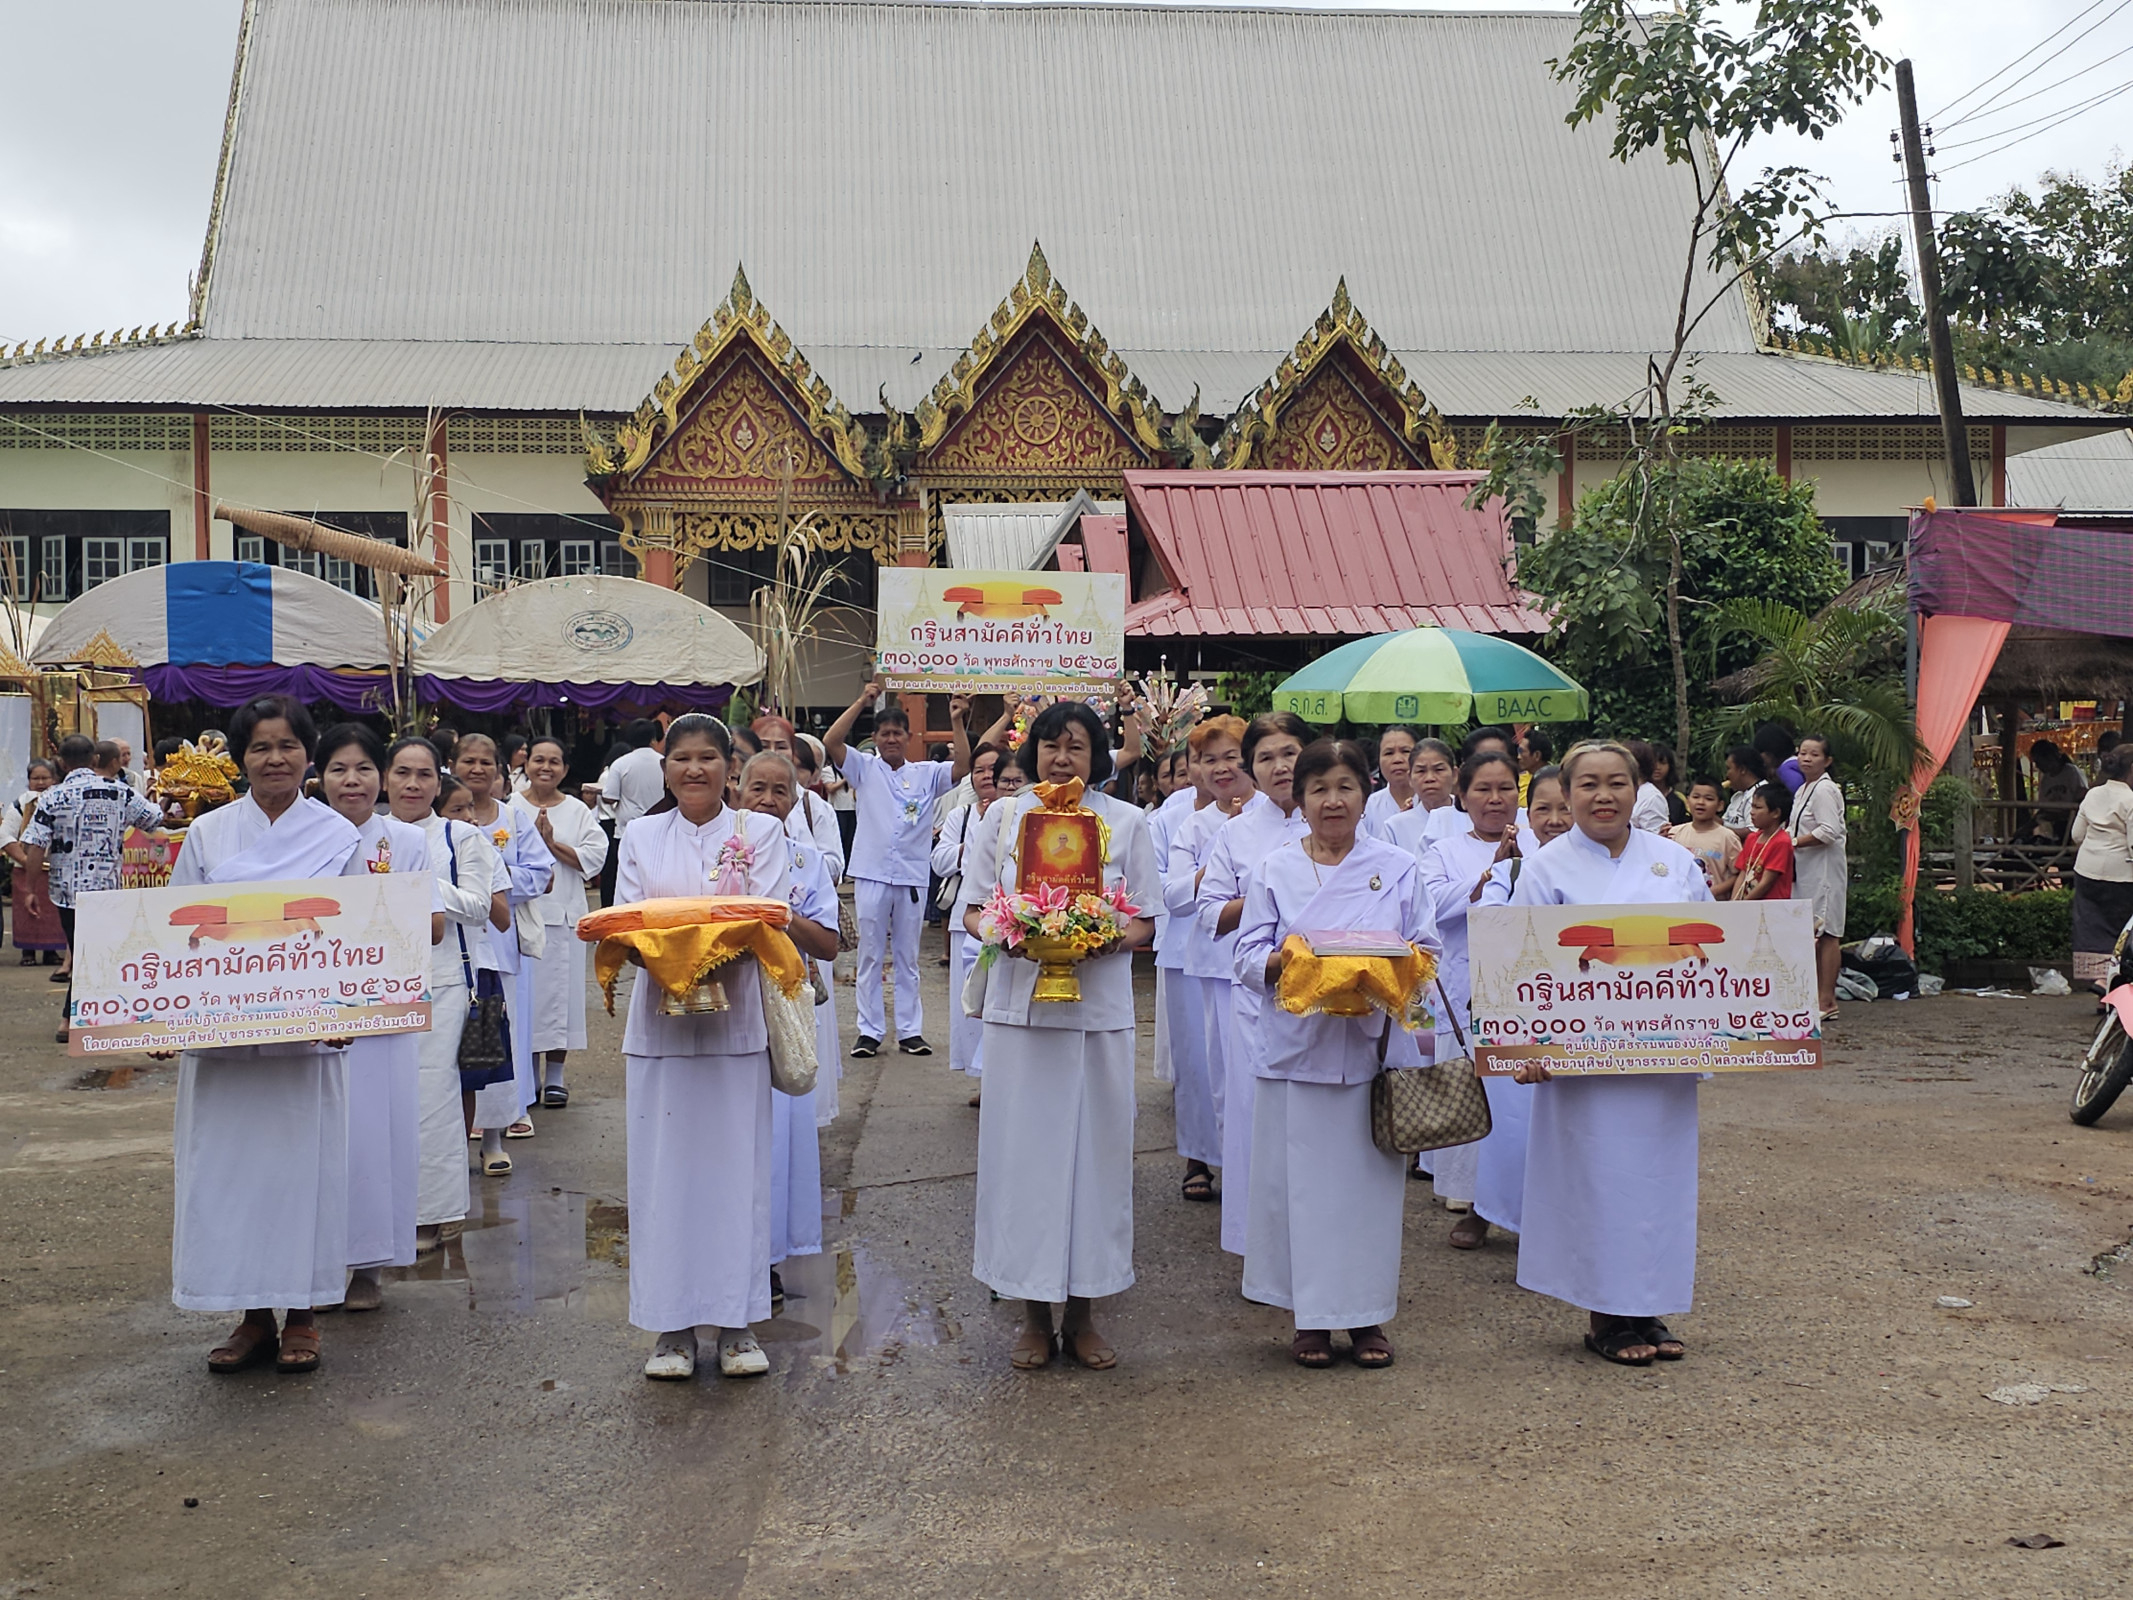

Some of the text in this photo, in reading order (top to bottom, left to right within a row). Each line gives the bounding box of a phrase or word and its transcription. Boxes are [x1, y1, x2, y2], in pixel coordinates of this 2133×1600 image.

[910, 617, 1093, 647] กฐินสามัคคีทั่วไทย
[884, 652, 1117, 672] ๓๐,๐๐๐ วัด พุทธศักราช ๒๕๖๘
[1289, 697, 1328, 716] ธ.ก.ส.
[1498, 696, 1552, 718] BAAC
[121, 934, 384, 989] กฐินสามัคคีทั่วไทย
[80, 975, 423, 1018] ๓๐,๐๐๐ วัด พุทธศักราช ๒๕๖๘
[1516, 961, 1771, 1010] กฐินสามัคคีทั่วไทย
[83, 1036, 109, 1051] โดย
[308, 1021, 317, 1033] ปี
[1482, 1009, 1811, 1039] ๓๐,๐๐๐ วัด พุทธศักราช ๒๕๖๘
[1488, 1057, 1514, 1071] โดย
[1701, 1053, 1710, 1066] ปี
